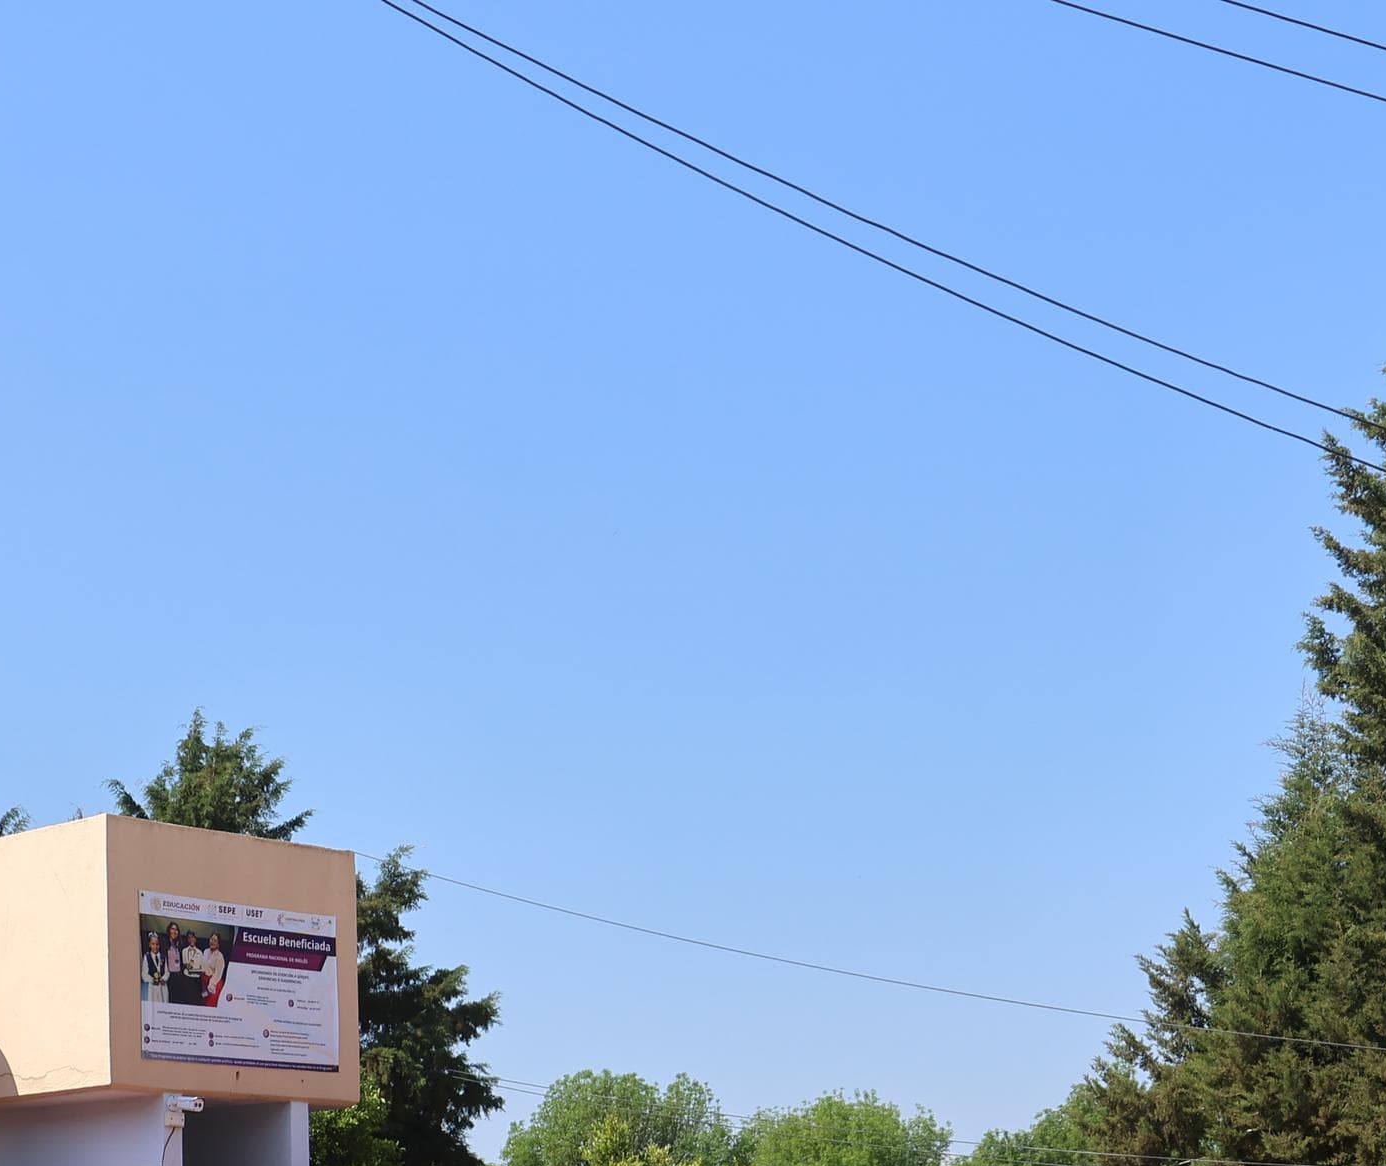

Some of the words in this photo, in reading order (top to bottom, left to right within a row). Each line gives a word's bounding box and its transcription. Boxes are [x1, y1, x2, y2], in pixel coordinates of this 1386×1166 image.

[163, 900, 200, 911] EDUCACIÓN
[219, 906, 236, 915] SEPE
[245, 909, 263, 919] USET
[243, 932, 277, 946] Escuela
[279, 936, 331, 952] Beneficiada
